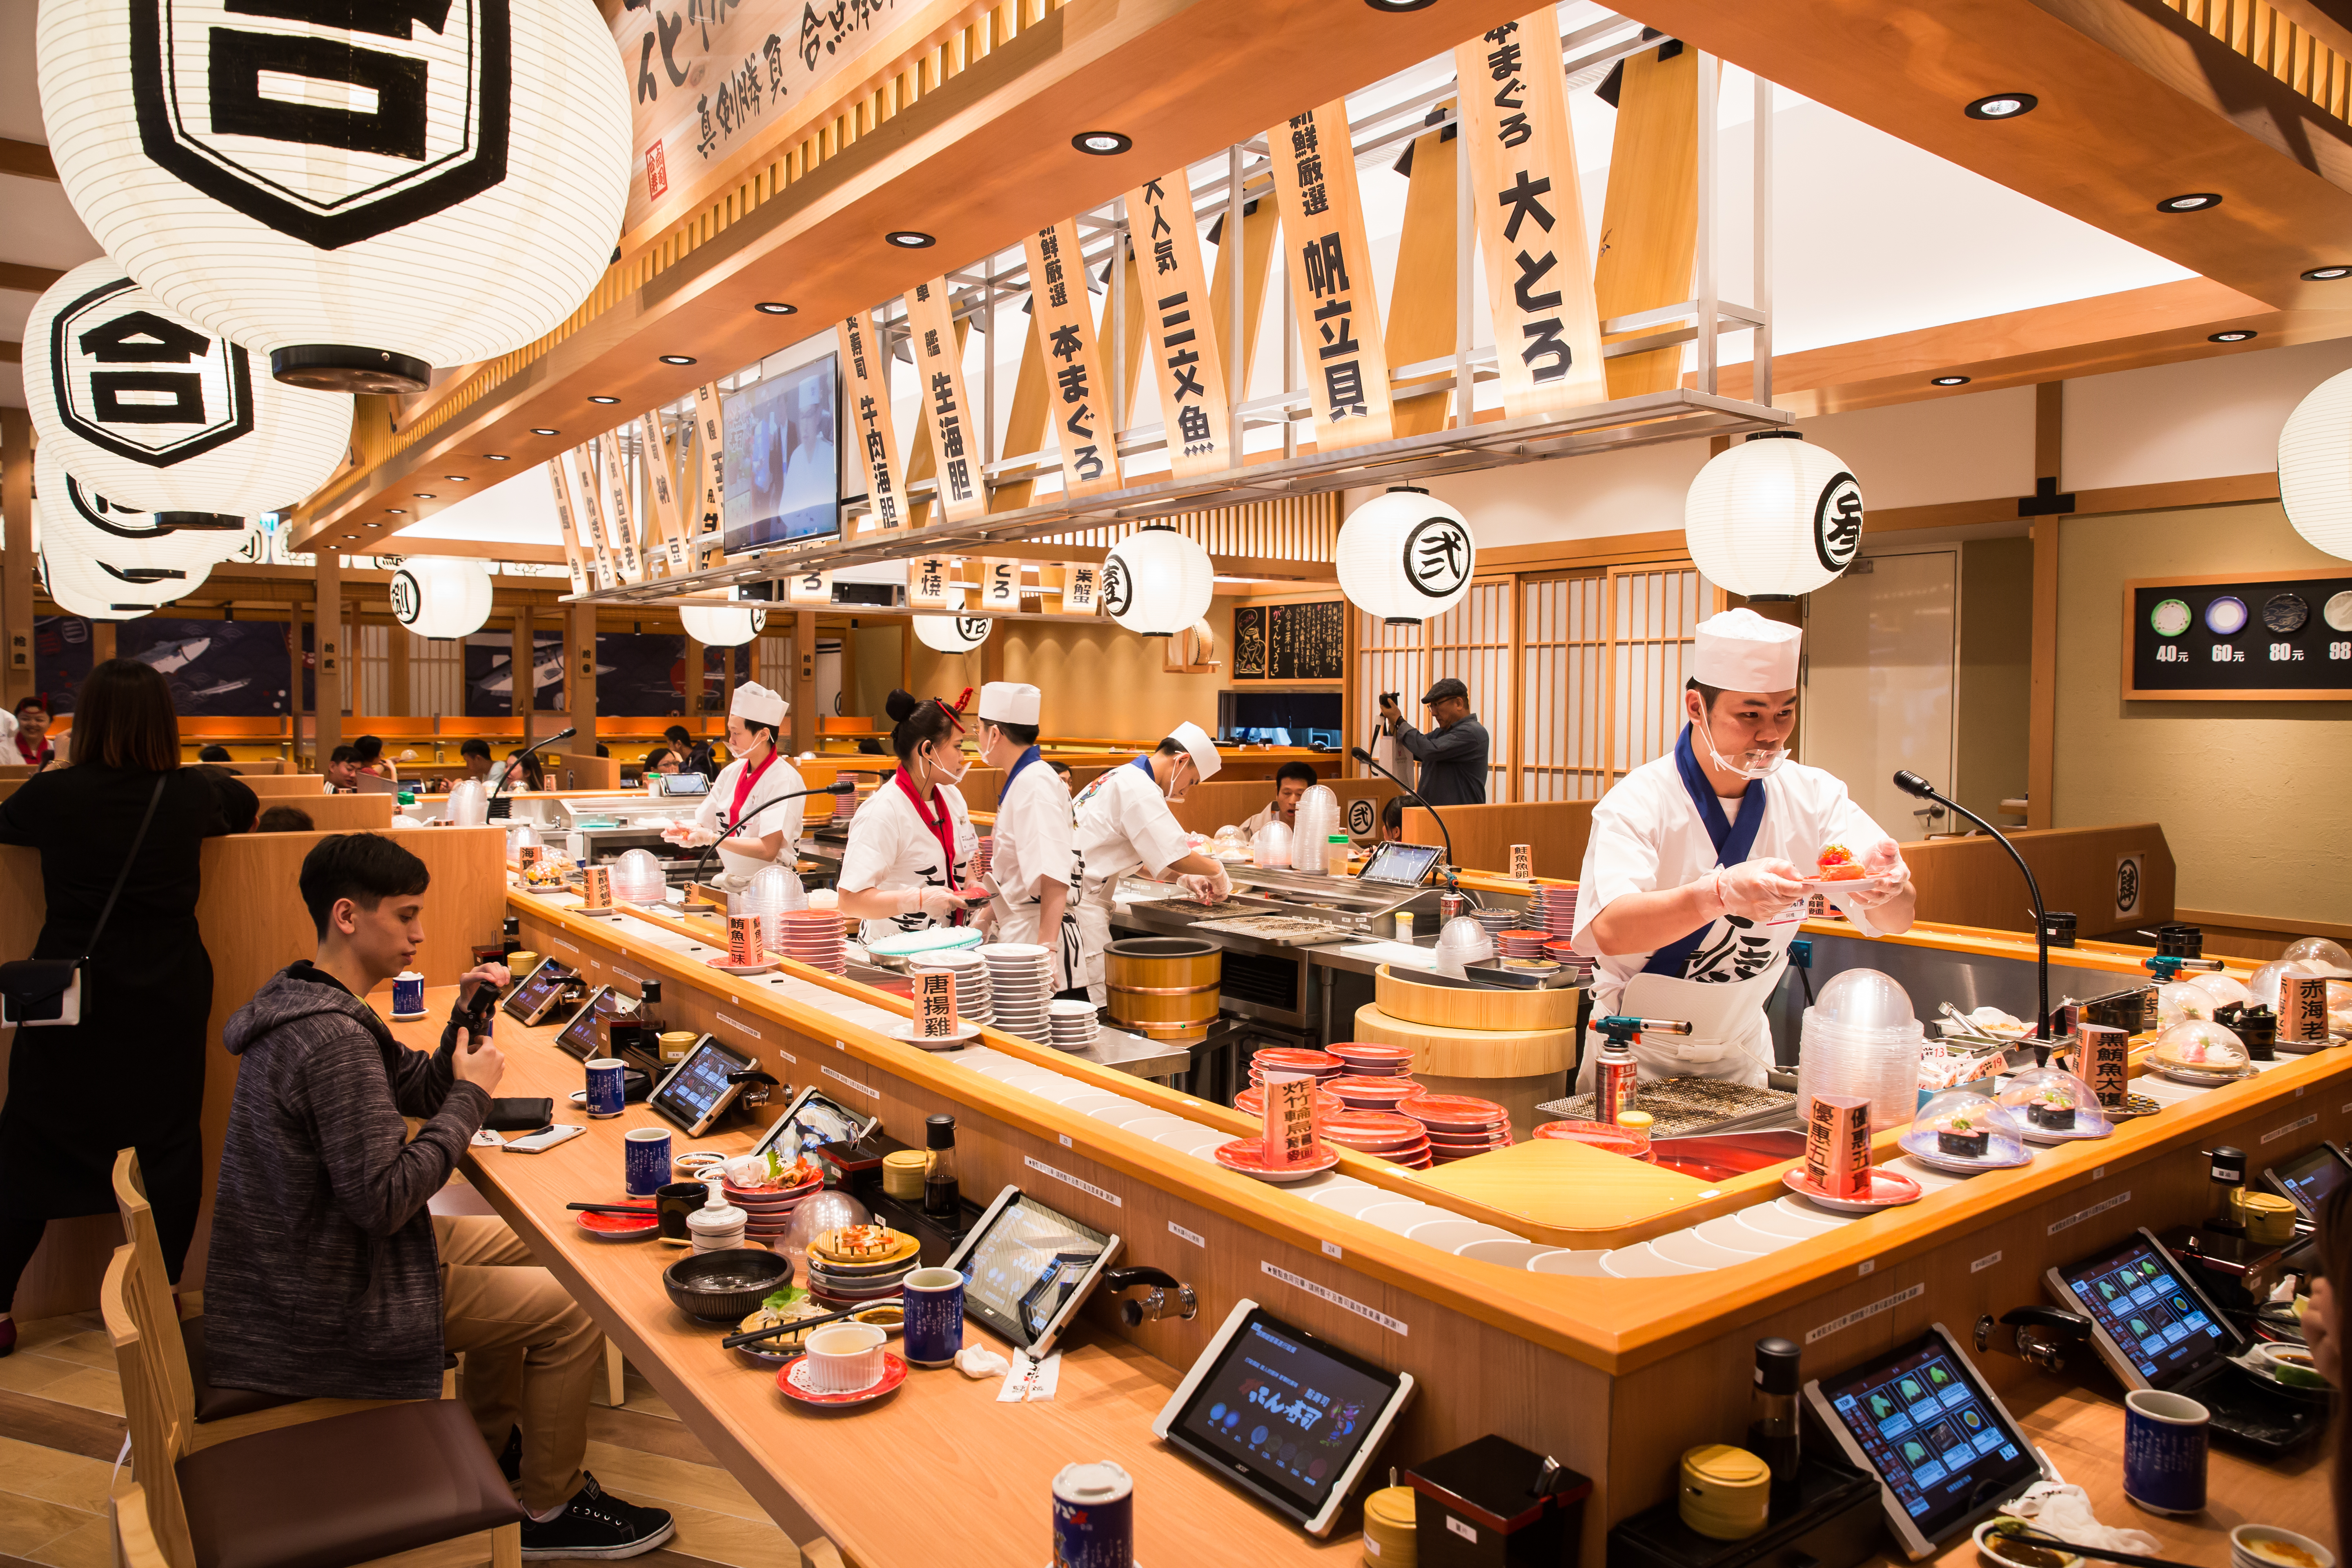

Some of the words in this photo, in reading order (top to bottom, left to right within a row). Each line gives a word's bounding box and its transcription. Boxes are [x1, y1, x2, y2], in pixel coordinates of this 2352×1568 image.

[697, 34, 787, 159] 真剣勝負
[1498, 170, 1572, 385] 大とろ
[1303, 232, 1366, 423] 帆立貝
[79, 310, 211, 425] 合
[1158, 291, 1214, 458] 三文魚
[932, 372, 973, 502] 生海胆
[1050, 324, 1104, 482] 本まぐろ
[860, 395, 898, 529] 牛肉海胆
[2156, 645, 2189, 662] 40元
[2212, 644, 2245, 662] 60元
[2269, 643, 2304, 661] 80元
[2329, 641, 2351, 660] 98
[1515, 846, 1528, 879] 鮭魚魚卵
[731, 918, 746, 965] 鮪魚三味
[923, 974, 951, 1038] 唐揚雞
[2300, 979, 2325, 1040] 赤海老
[1934, 1047, 1944, 1058] 13
[1992, 1057, 2002, 1069] 19
[2096, 1033, 2124, 1106] 黑鮪魚大腹
[1283, 1080, 1313, 1163] 炸竹輪烏龍麵
[1808, 1100, 1835, 1190] 優惠五貫
[1839, 1398, 1851, 1408] TOP
